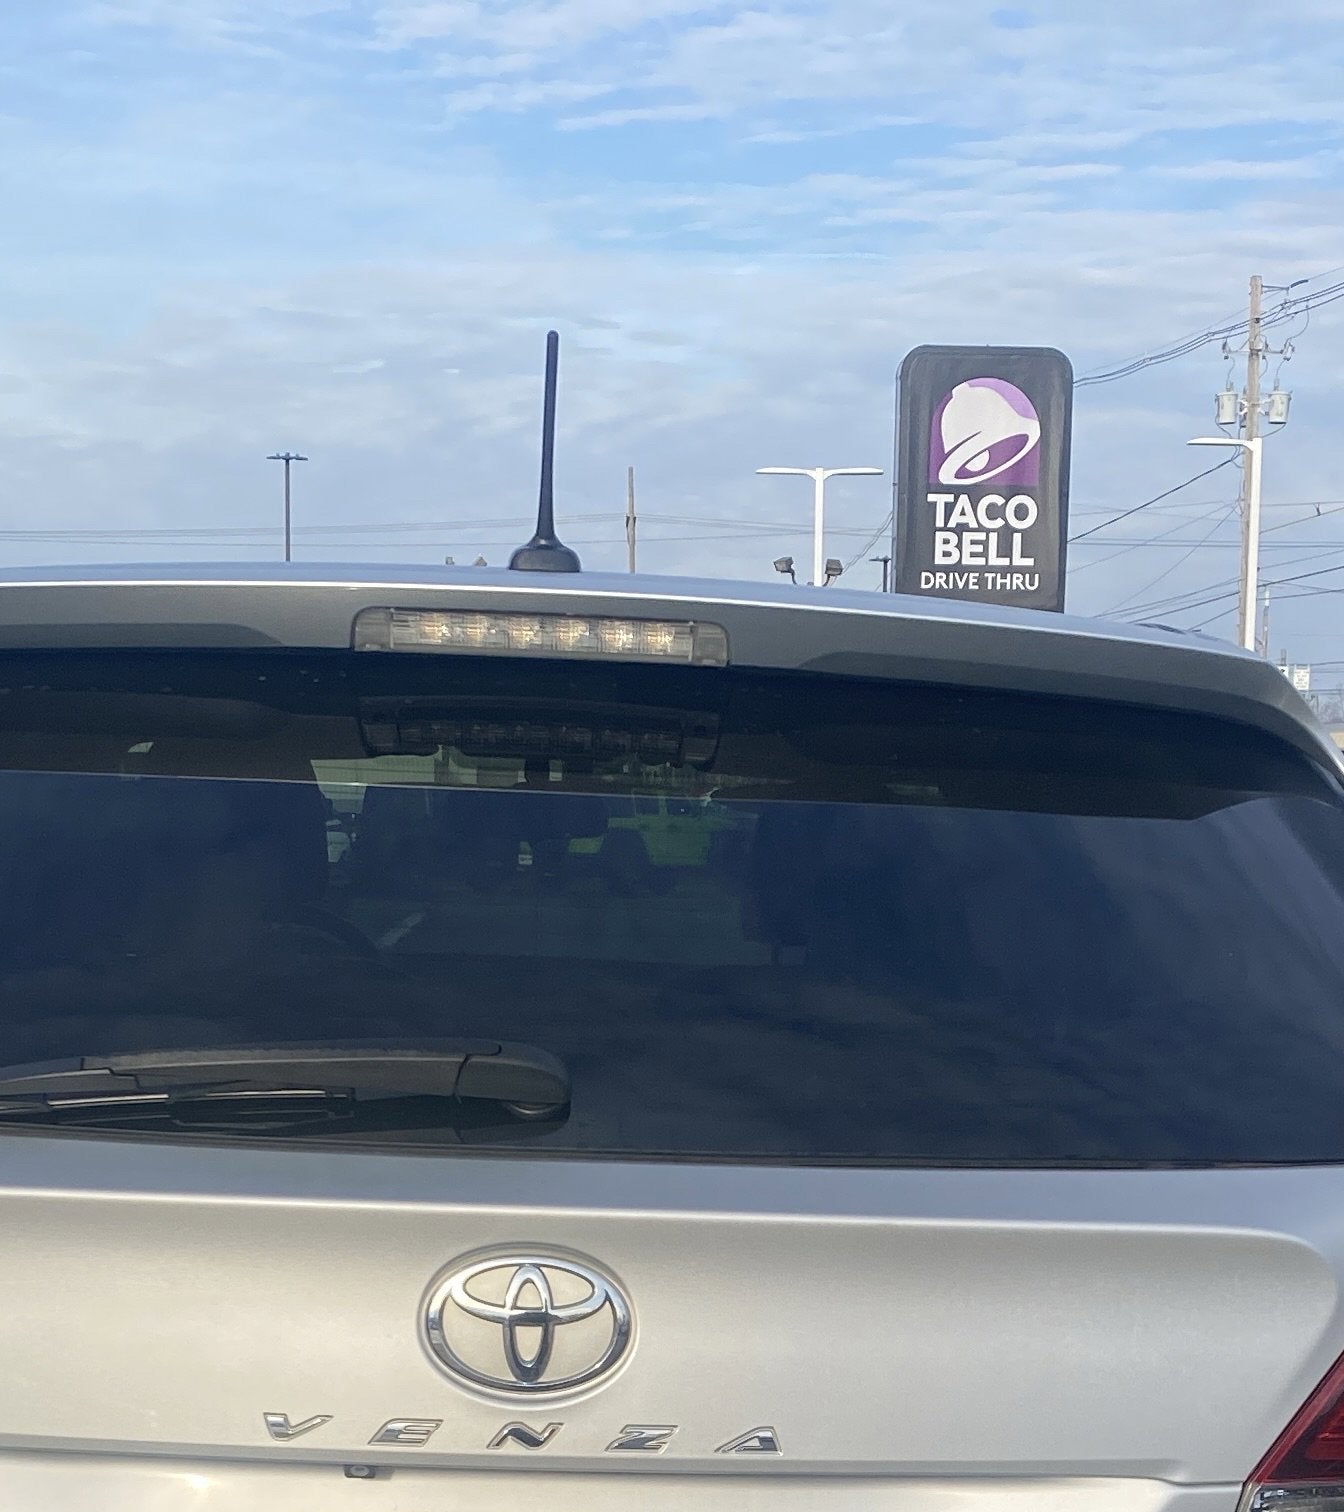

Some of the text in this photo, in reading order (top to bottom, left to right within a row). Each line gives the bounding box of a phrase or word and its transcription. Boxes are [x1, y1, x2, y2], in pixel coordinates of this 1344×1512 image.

[927, 493, 1038, 529] TACO
[934, 531, 1035, 566] BELL
[920, 571, 1040, 591] DRIVE THRU
[262, 1411, 785, 1457] VENZA
